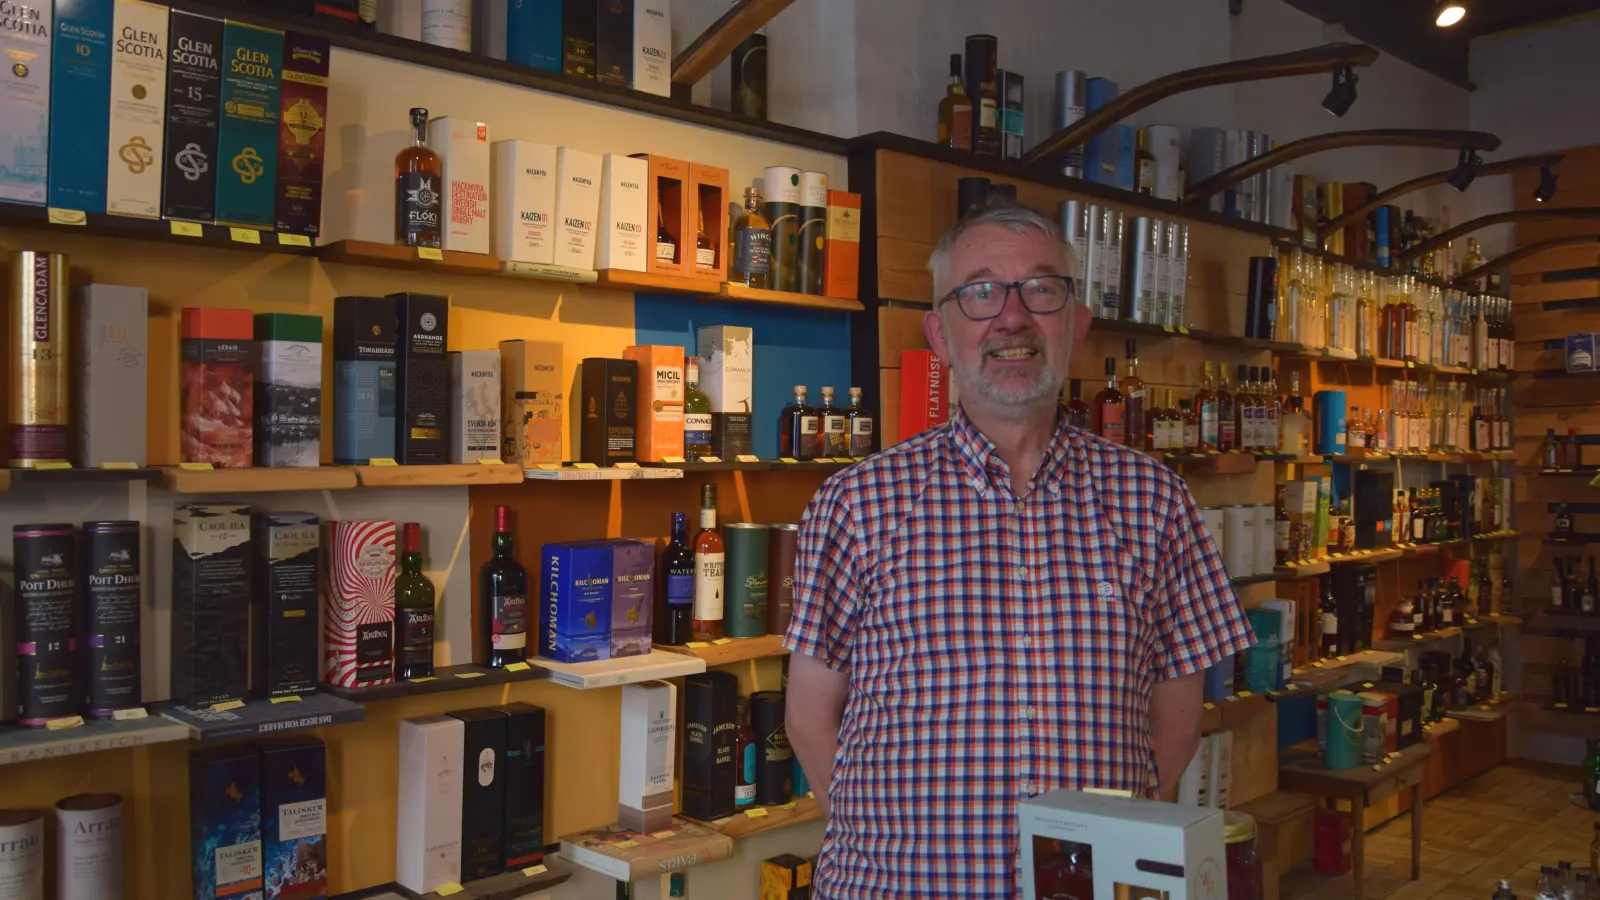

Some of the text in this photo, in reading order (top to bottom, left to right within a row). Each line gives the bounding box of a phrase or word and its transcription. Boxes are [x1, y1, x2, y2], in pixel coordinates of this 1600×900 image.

[122, 26, 157, 44] GLEN
[75, 43, 91, 57] 10
[116, 39, 164, 60] SCOTIA
[178, 37, 212, 55] GLEN
[642, 46, 660, 57] KAIZEN
[172, 49, 218, 70] SCOTIA
[236, 47, 269, 64] GLEN
[231, 59, 274, 79] SCOTIA
[187, 86, 202, 102] 15
[452, 181, 484, 193] MACKMYRA
[452, 190, 487, 202] DESTINATION
[452, 198, 476, 209] SWEDISH
[409, 209, 437, 222] FLÓKI
[520, 211, 541, 222] KAIZEN
[564, 218, 584, 228] KAIZEN
[616, 222, 636, 232] KAIZEN
[36, 257, 48, 340] GLENCADAM
[358, 346, 394, 354] TORABHAIG
[656, 370, 680, 380] MICIL
[928, 355, 940, 418] FLATNÖSE
[199, 521, 246, 532] CAOL ILA
[274, 531, 316, 541] CAOL ILA
[548, 556, 560, 651] KILCHOMAN
[258, 715, 332, 732] DAS BUCH VOM MARKT
[686, 722, 707, 732] JAMESON
[712, 722, 736, 735] JAMESON
[10, 735, 143, 762] RANKREICH
[717, 746, 730, 754] BLACK
[716, 756, 731, 764] BARREL
[283, 804, 324, 816] TALISKER
[74, 817, 121, 834] Arran
[0, 834, 38, 852] rran
[220, 846, 259, 860] TALISKER
[659, 854, 696, 870] PARIS
[244, 864, 251, 875] 10
